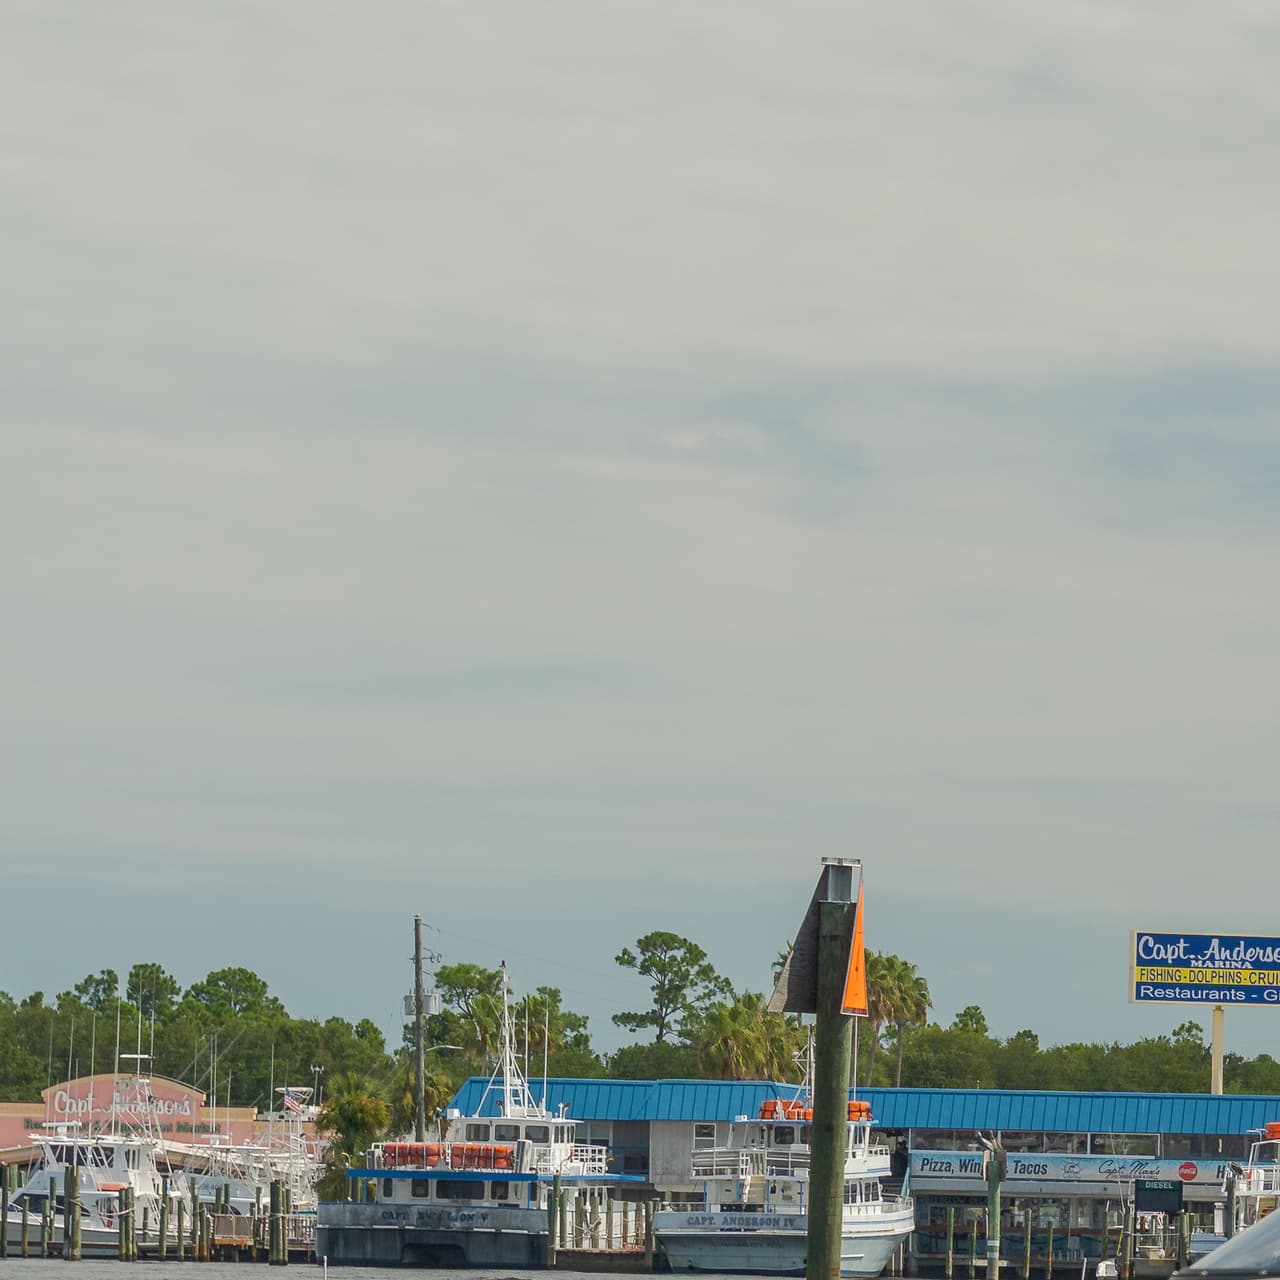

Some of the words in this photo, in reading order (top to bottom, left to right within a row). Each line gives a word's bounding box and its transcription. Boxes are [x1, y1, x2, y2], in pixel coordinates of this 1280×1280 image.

[1138, 935, 1197, 963] Capt.
[1190, 959, 1253, 969] MARINA
[1139, 968, 1182, 982] FISHING
[1189, 969, 1242, 984] DOLPHINS
[1140, 985, 1246, 1000] Restaurants
[920, 1157, 955, 1174] Pizza,
[1013, 1159, 1048, 1175] Tacos
[1145, 1181, 1173, 1189] DIESEL
[687, 1215, 716, 1226] CAPT.
[721, 1216, 780, 1227] ANDERSON
[783, 1217, 797, 1227] IV
